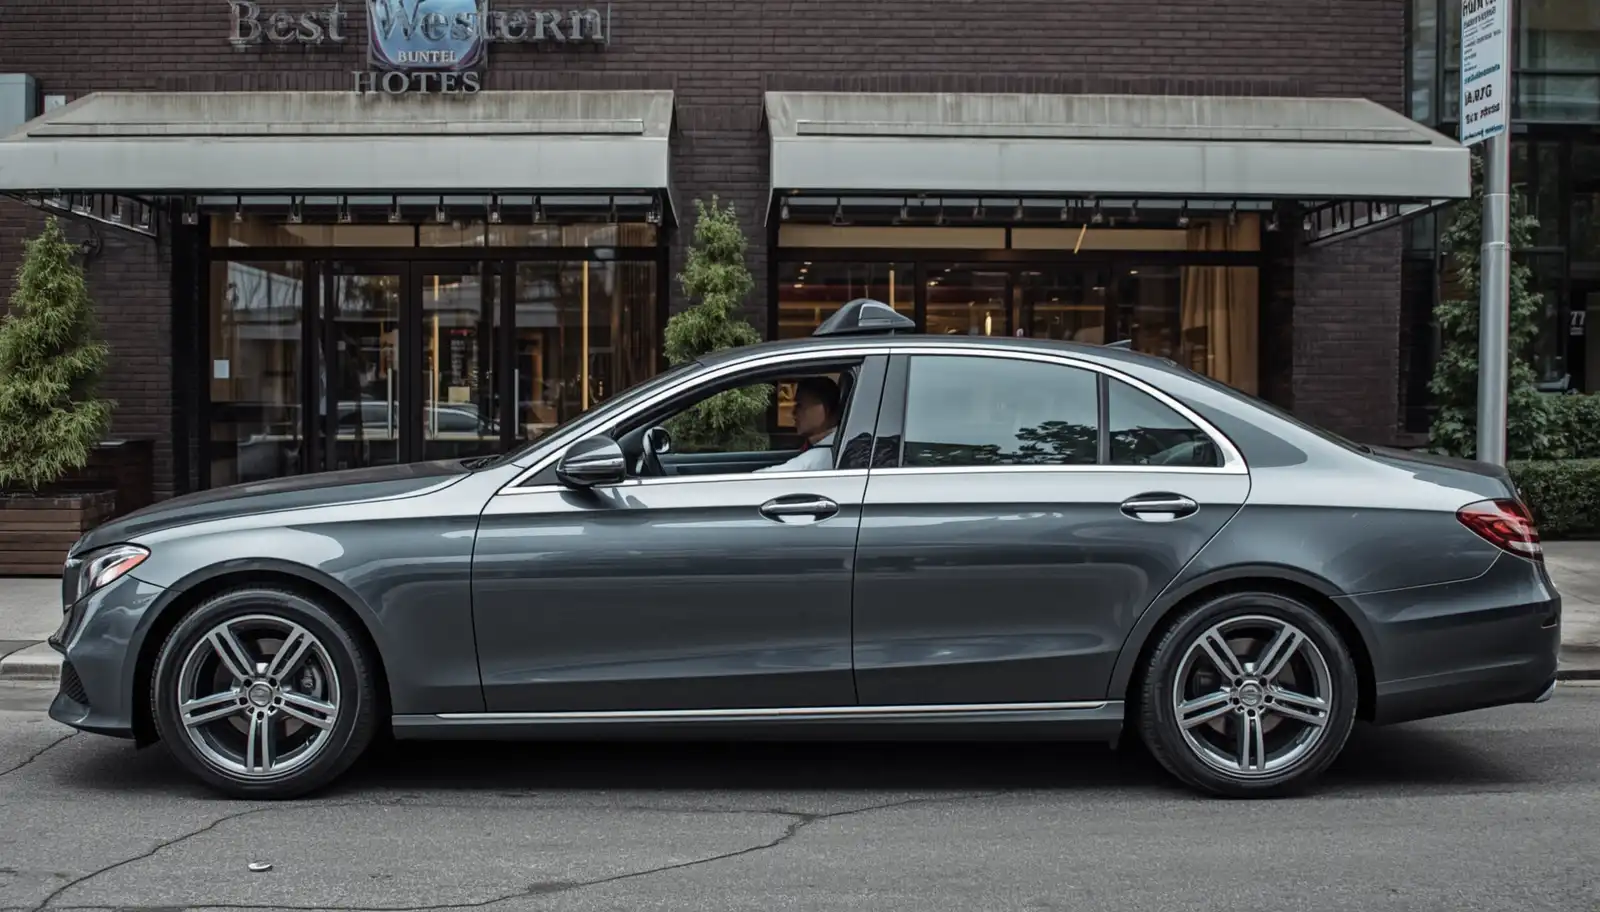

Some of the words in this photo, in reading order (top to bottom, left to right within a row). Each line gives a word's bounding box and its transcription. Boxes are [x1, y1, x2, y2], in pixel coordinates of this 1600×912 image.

[228, 0, 348, 44] Best
[398, 50, 457, 63] BUNTEL
[352, 71, 481, 95] HOTES
